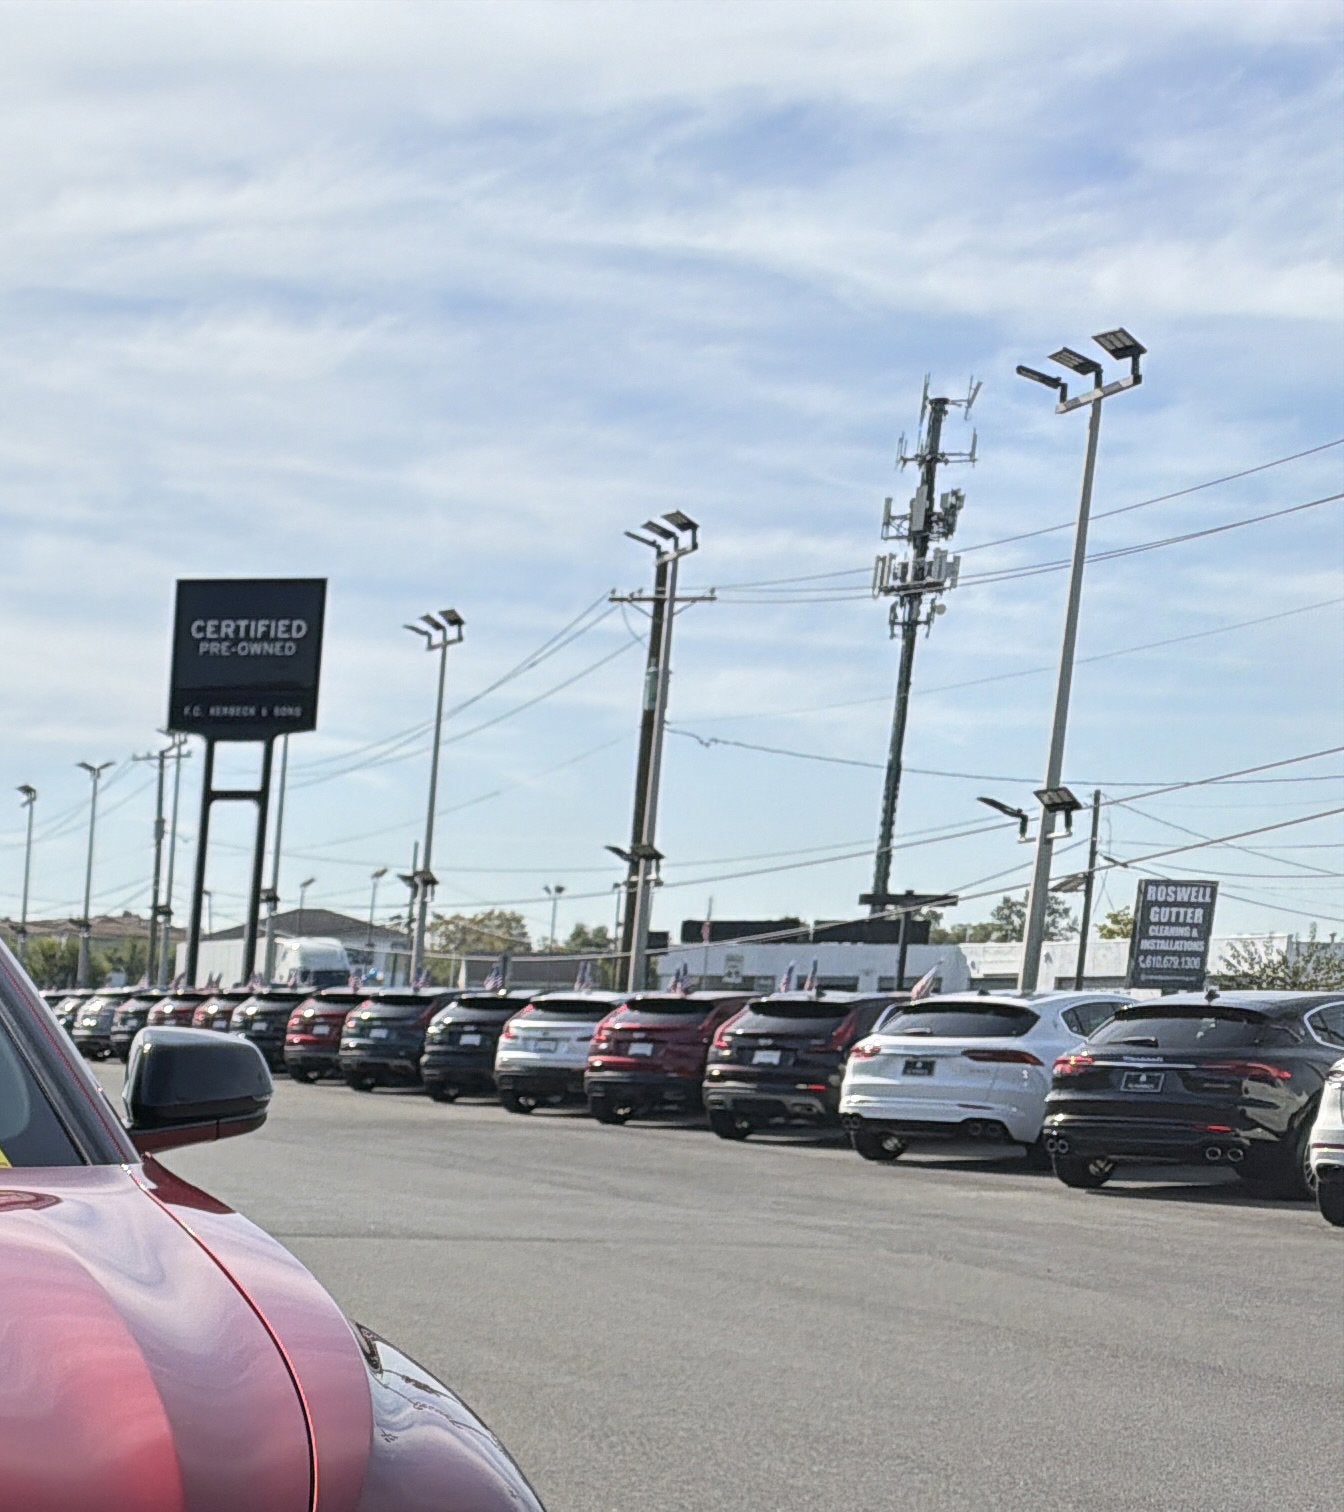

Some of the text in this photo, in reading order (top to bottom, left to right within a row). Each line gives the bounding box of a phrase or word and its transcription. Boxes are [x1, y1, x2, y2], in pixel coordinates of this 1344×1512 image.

[190, 619, 308, 639] CERTIFIED
[198, 641, 297, 656] PRE-OWNED
[1146, 885, 1212, 903] ROSWELL
[1149, 906, 1204, 924] GUTTER
[1140, 938, 1205, 952] INSTALLATIONS
